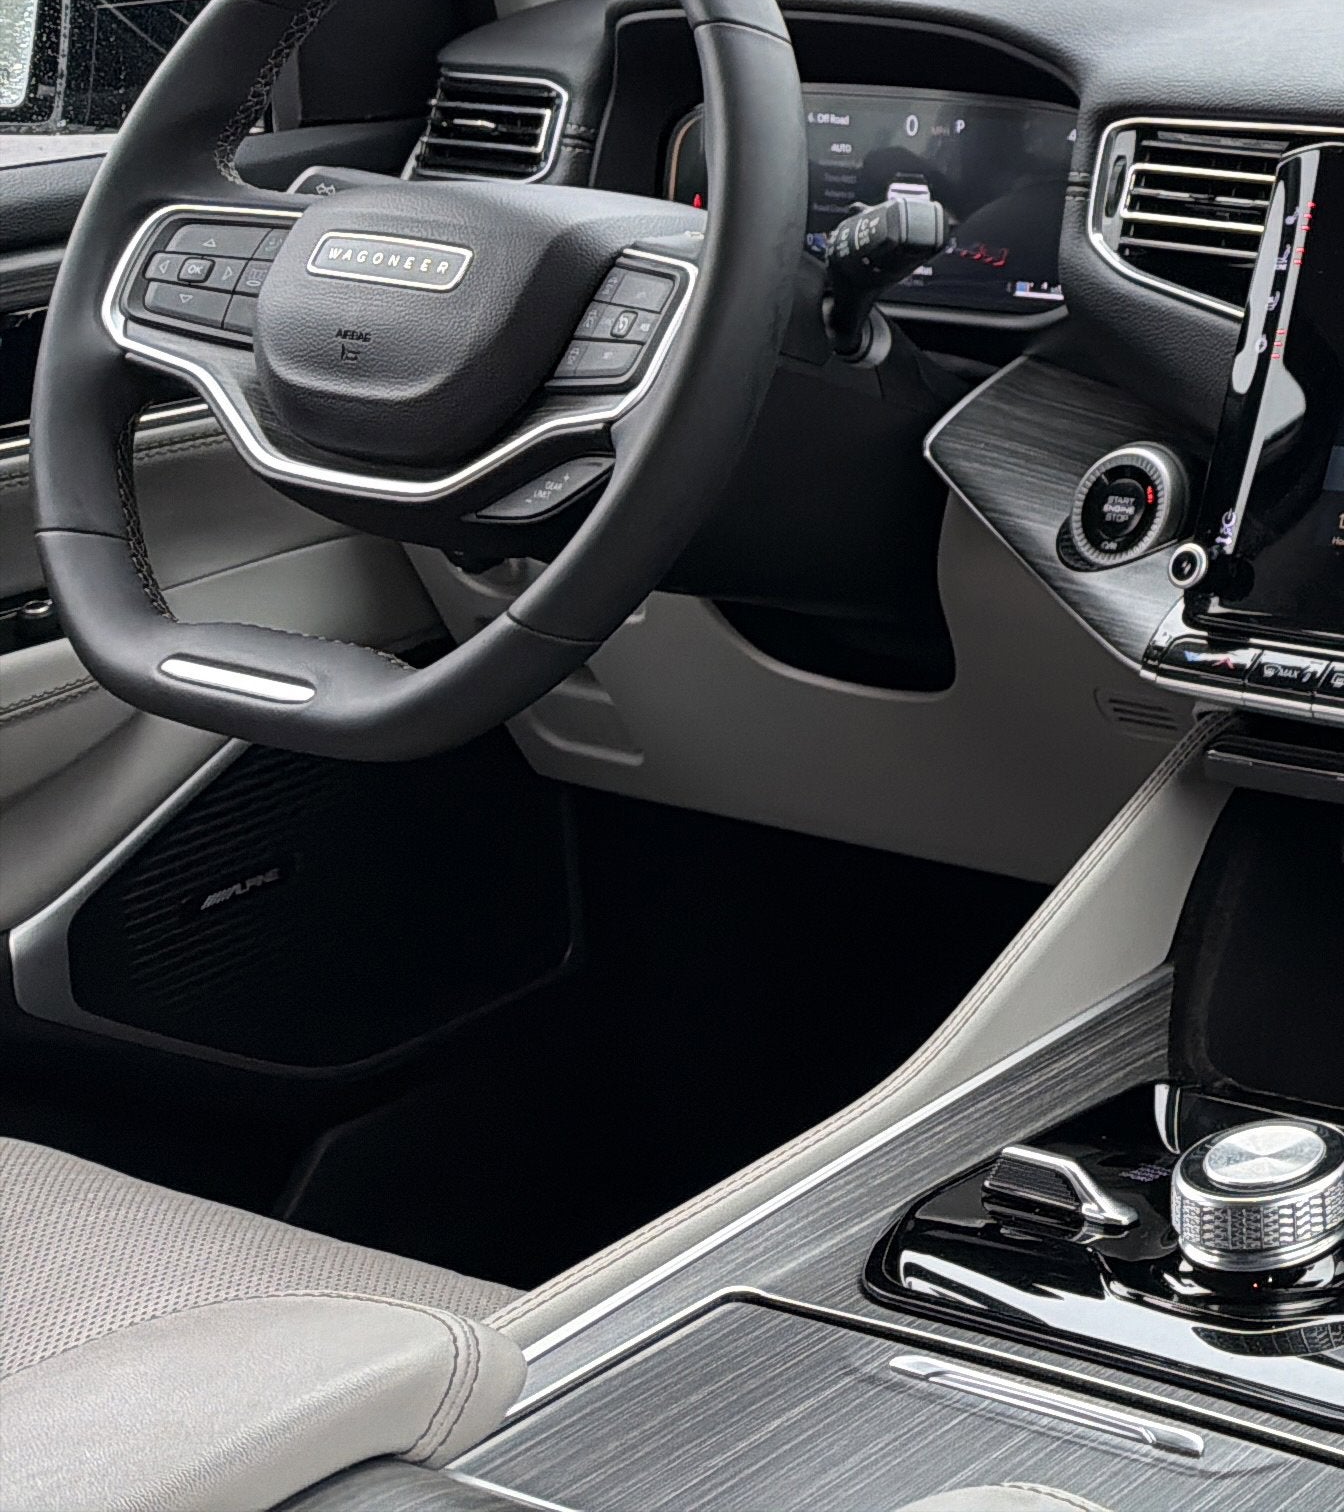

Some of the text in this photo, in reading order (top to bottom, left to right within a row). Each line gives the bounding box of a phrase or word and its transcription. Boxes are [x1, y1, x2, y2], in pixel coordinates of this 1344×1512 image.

[905, 114, 919, 137] 0
[328, 247, 449, 274] WAGONEER
[1107, 495, 1136, 505] START
[1105, 514, 1129, 523] STOP
